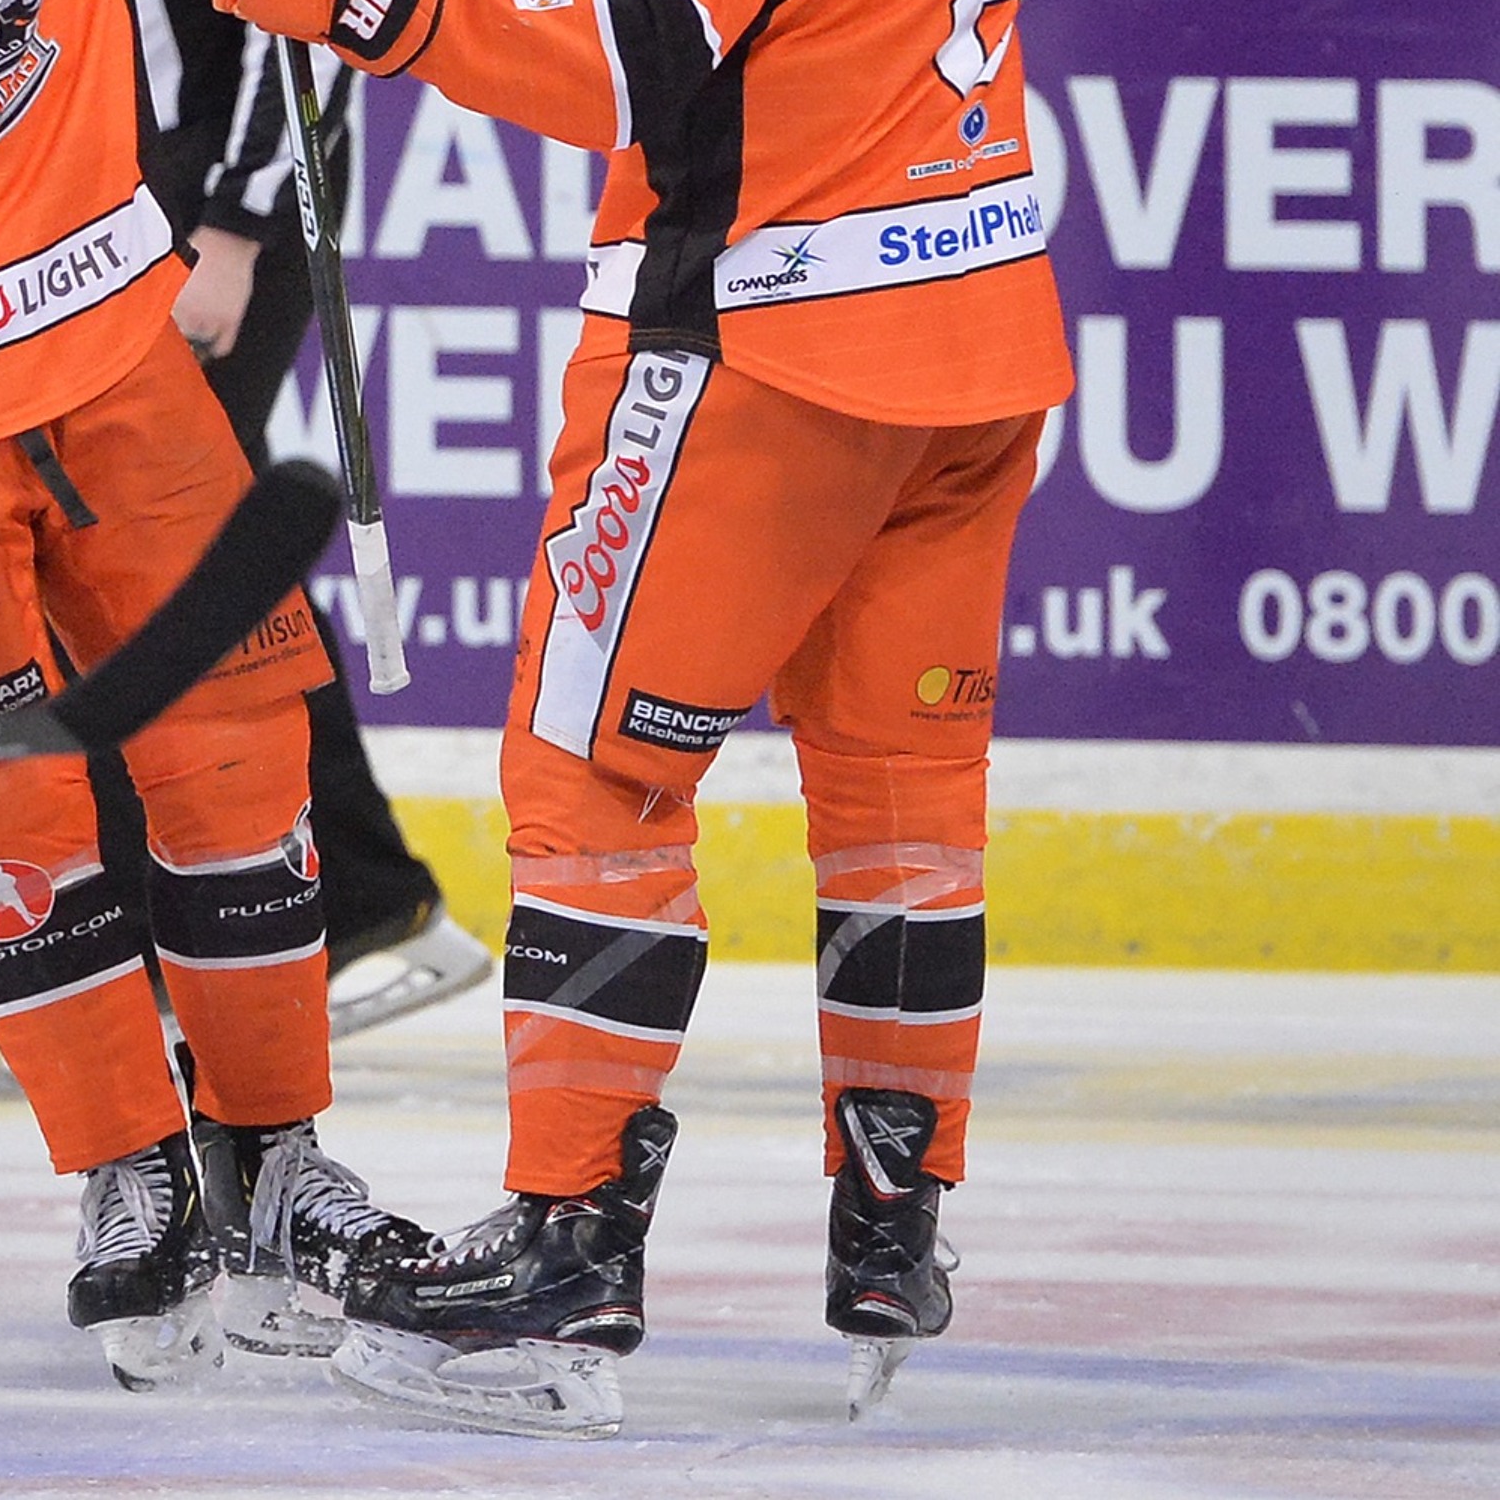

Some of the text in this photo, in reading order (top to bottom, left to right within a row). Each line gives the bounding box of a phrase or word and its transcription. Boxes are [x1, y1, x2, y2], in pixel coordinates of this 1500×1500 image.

[560, 455, 651, 632] Coors
[1237, 569, 1500, 667] 0800
[628, 718, 703, 745] Kitchens
